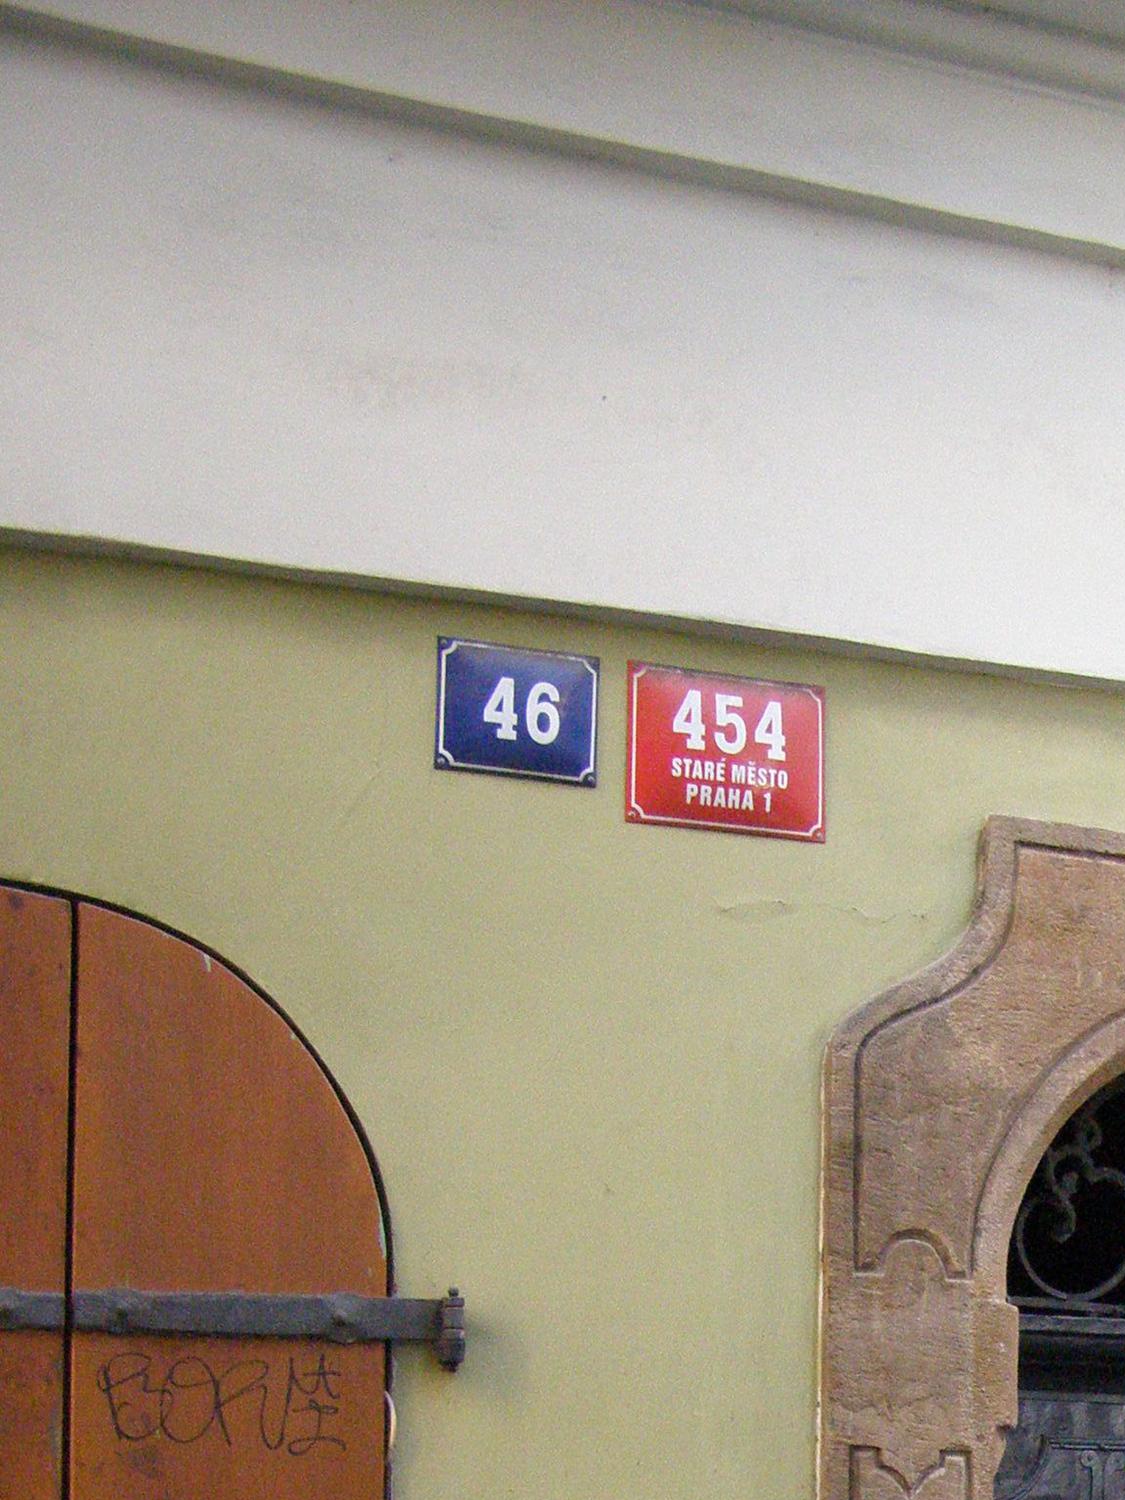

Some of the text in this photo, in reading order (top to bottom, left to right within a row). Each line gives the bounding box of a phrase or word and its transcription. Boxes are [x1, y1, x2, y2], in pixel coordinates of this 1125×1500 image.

[483, 676, 560, 745] 46
[672, 688, 786, 762] 454
[671, 756, 788, 790] STARÉ MĚSTO
[686, 783, 772, 813] PRAHA 1
